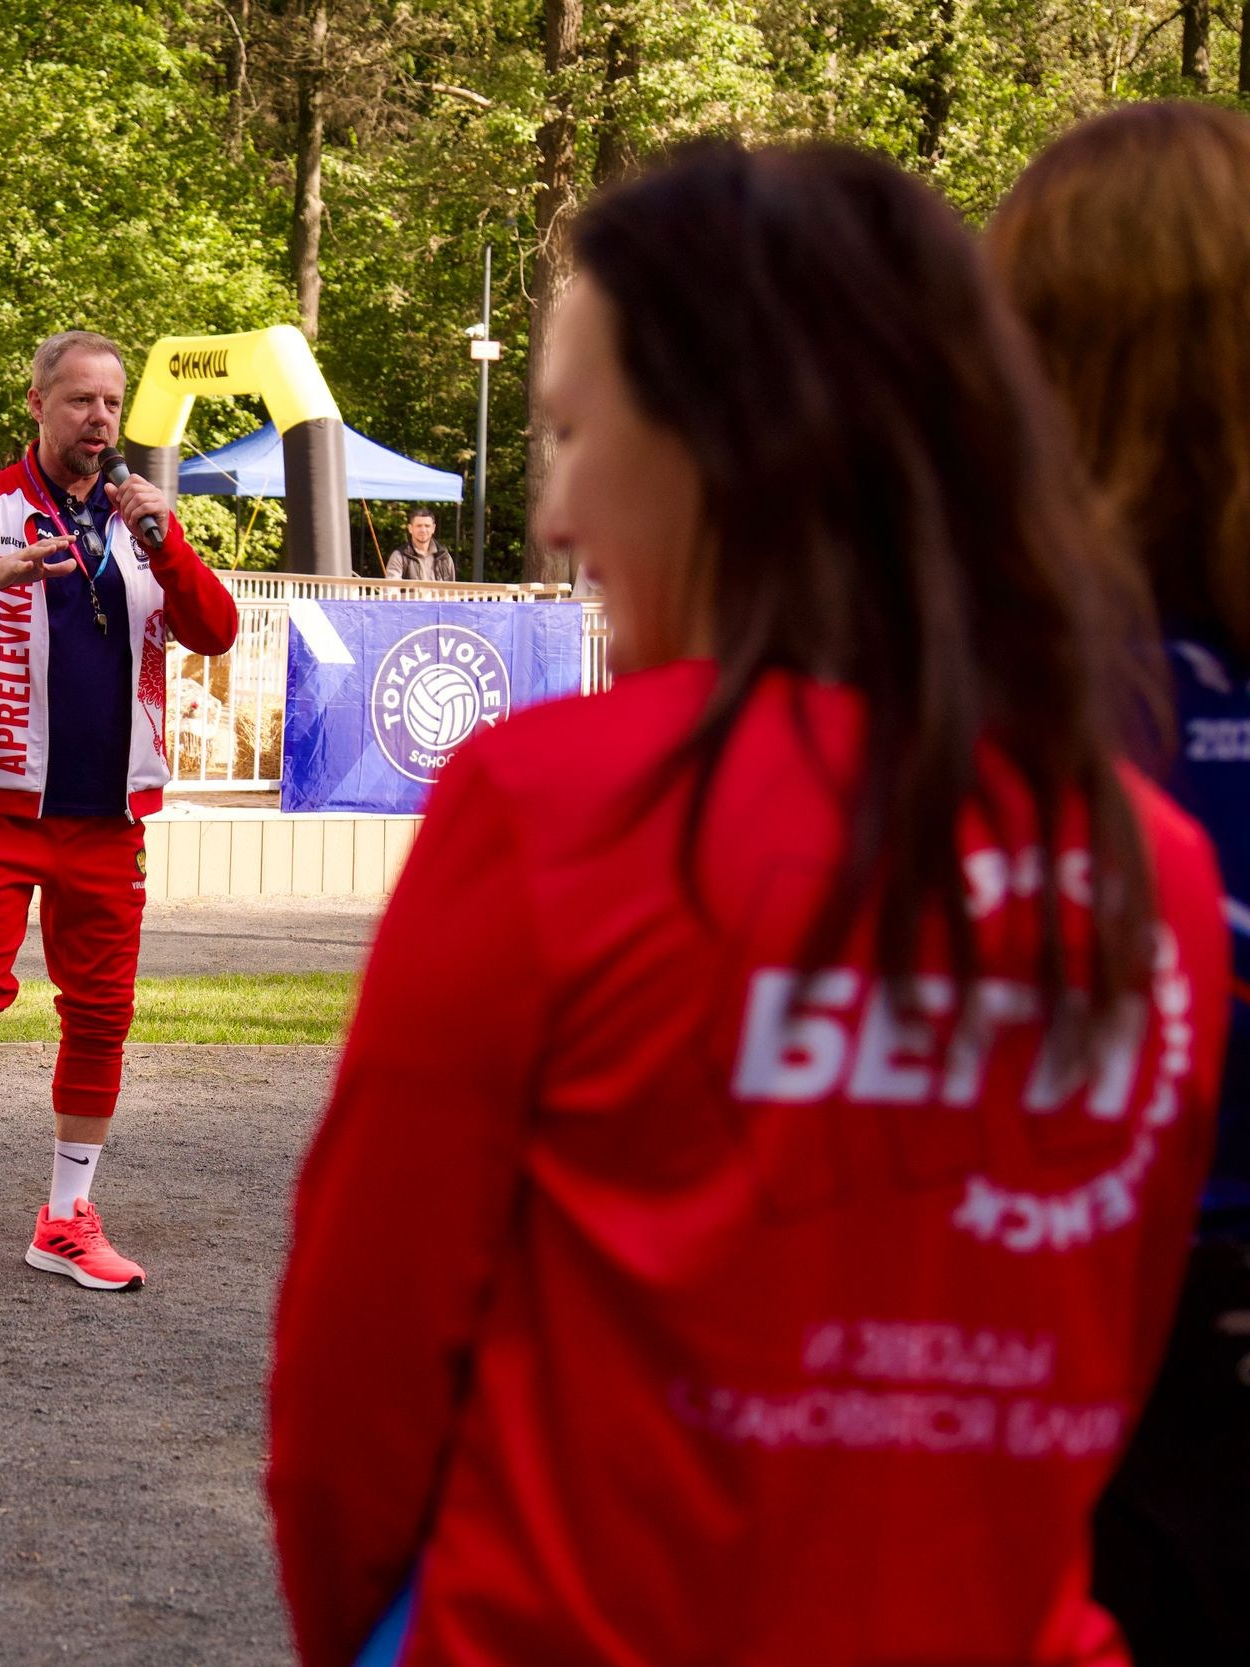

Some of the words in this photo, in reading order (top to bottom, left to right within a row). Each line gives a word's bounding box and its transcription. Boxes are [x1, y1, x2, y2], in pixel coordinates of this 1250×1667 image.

[168, 349, 230, 381] ФИНИШ
[382, 643, 432, 731] TOTAL
[438, 636, 501, 729] VOLLEY
[408, 749, 456, 769] SCHO
[732, 966, 1150, 1120] БЕГИ
